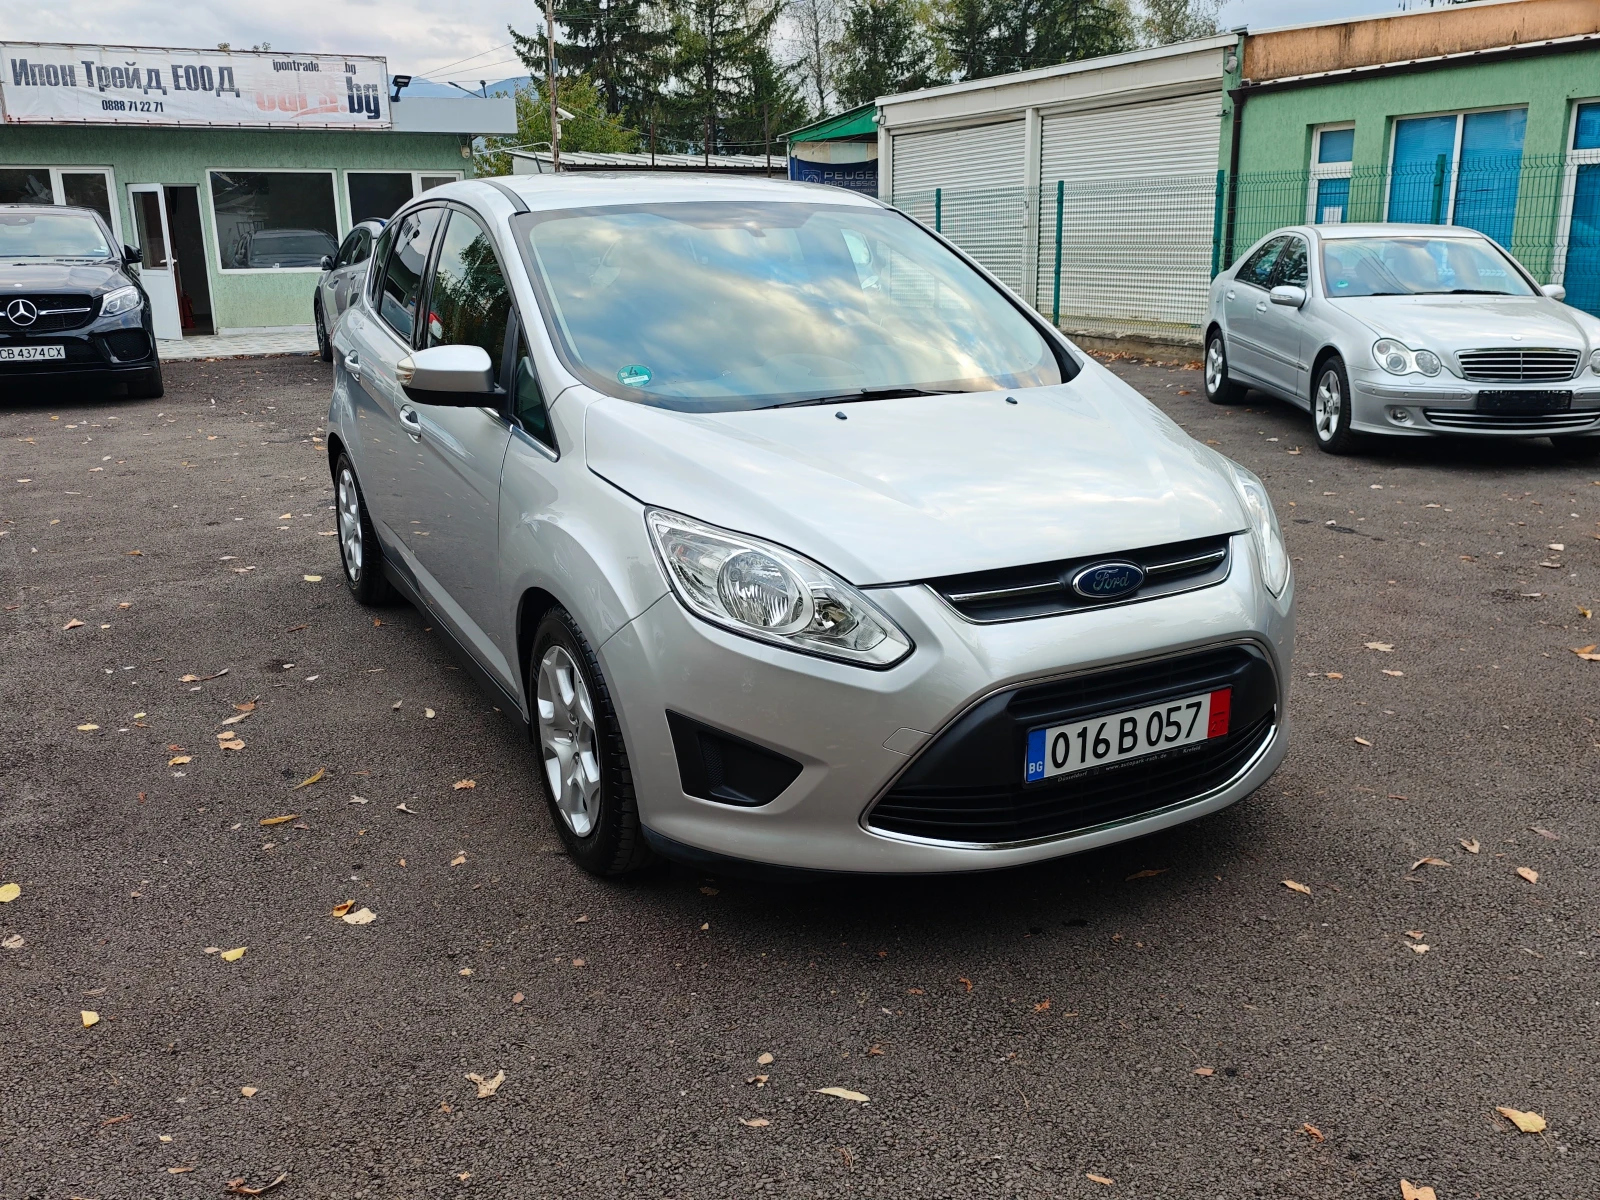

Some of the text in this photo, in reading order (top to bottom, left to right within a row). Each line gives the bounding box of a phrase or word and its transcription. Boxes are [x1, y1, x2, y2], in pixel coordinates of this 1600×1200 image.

[10, 58, 241, 98] Ипон Трейд ЕООД
[101, 99, 164, 113] 0888 71 22 71
[0, 347, 63, 360] CB 4374 CX
[1092, 568, 1130, 591] Ford
[1028, 761, 1043, 775] BG
